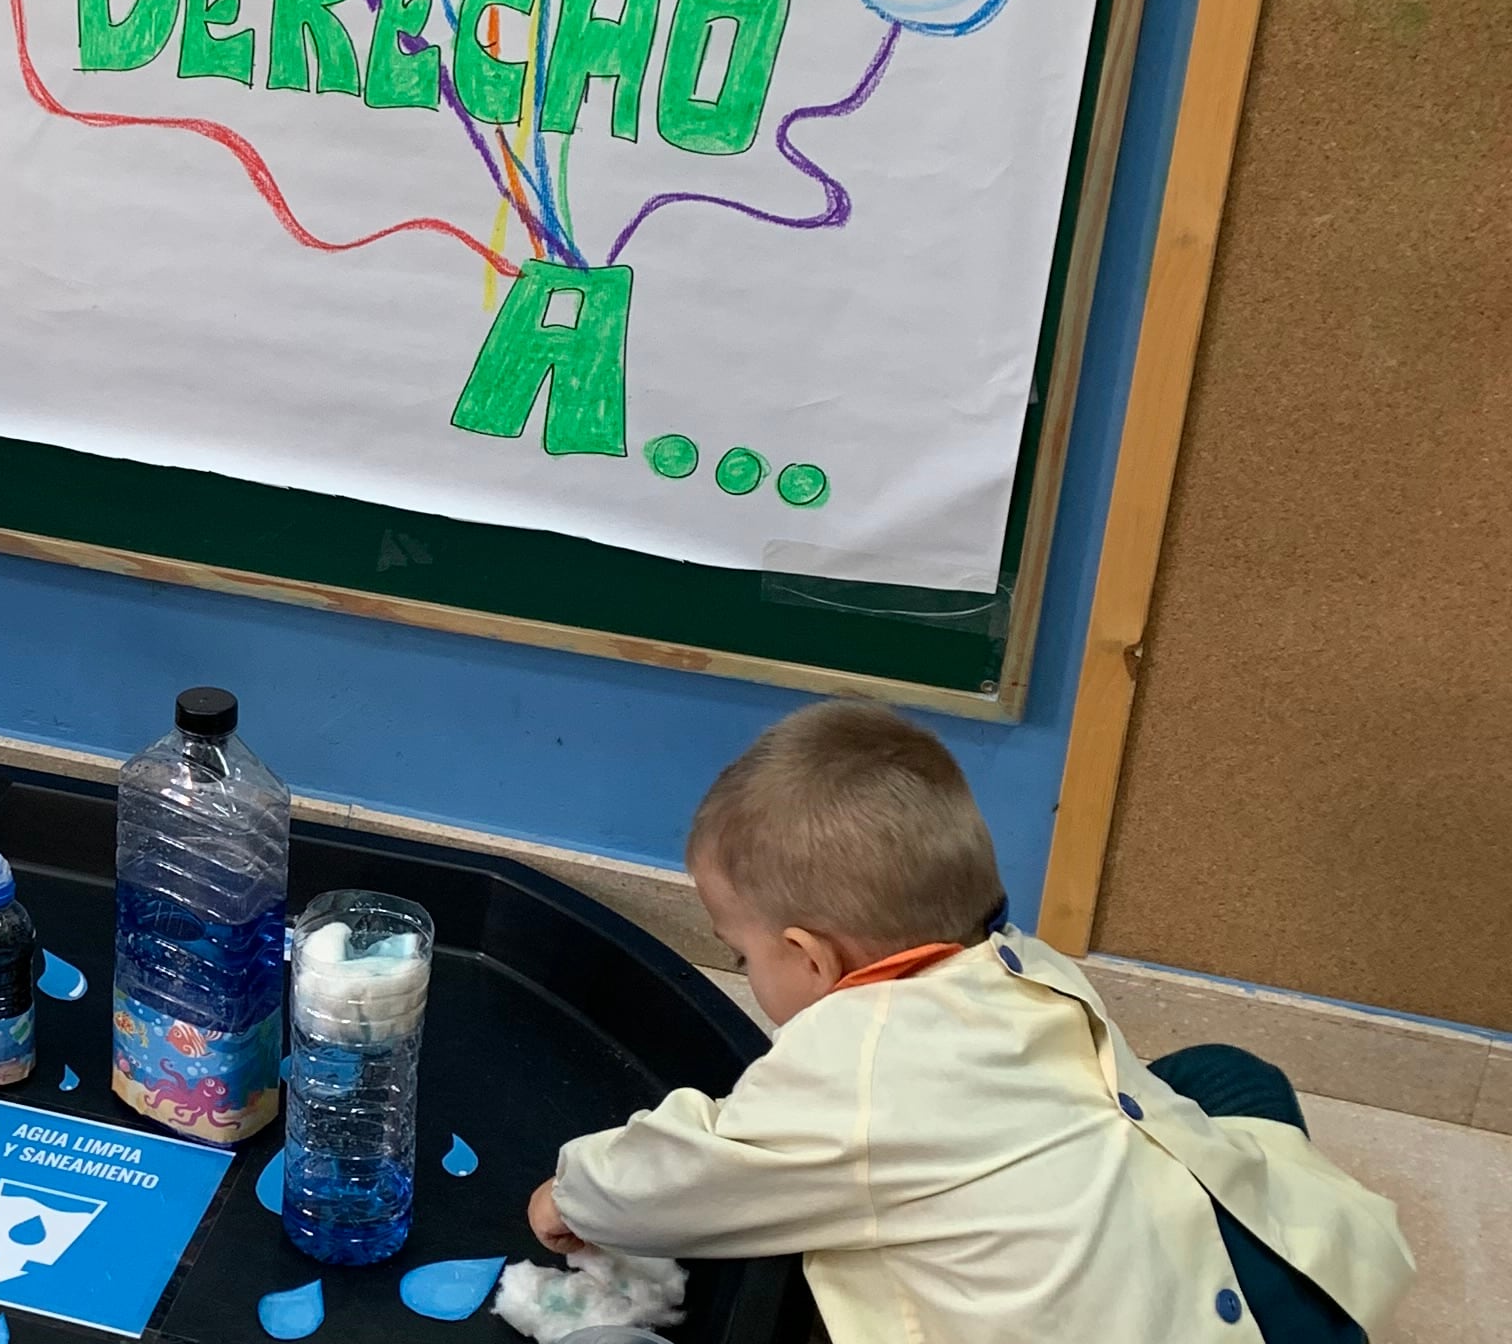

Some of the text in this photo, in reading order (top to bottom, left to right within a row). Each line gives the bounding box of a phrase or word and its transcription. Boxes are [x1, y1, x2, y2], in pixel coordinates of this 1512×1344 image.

[12, 1123, 143, 1164] AGUA LIMPIA
[1, 1142, 160, 1190] Y SANEAMIENTO
